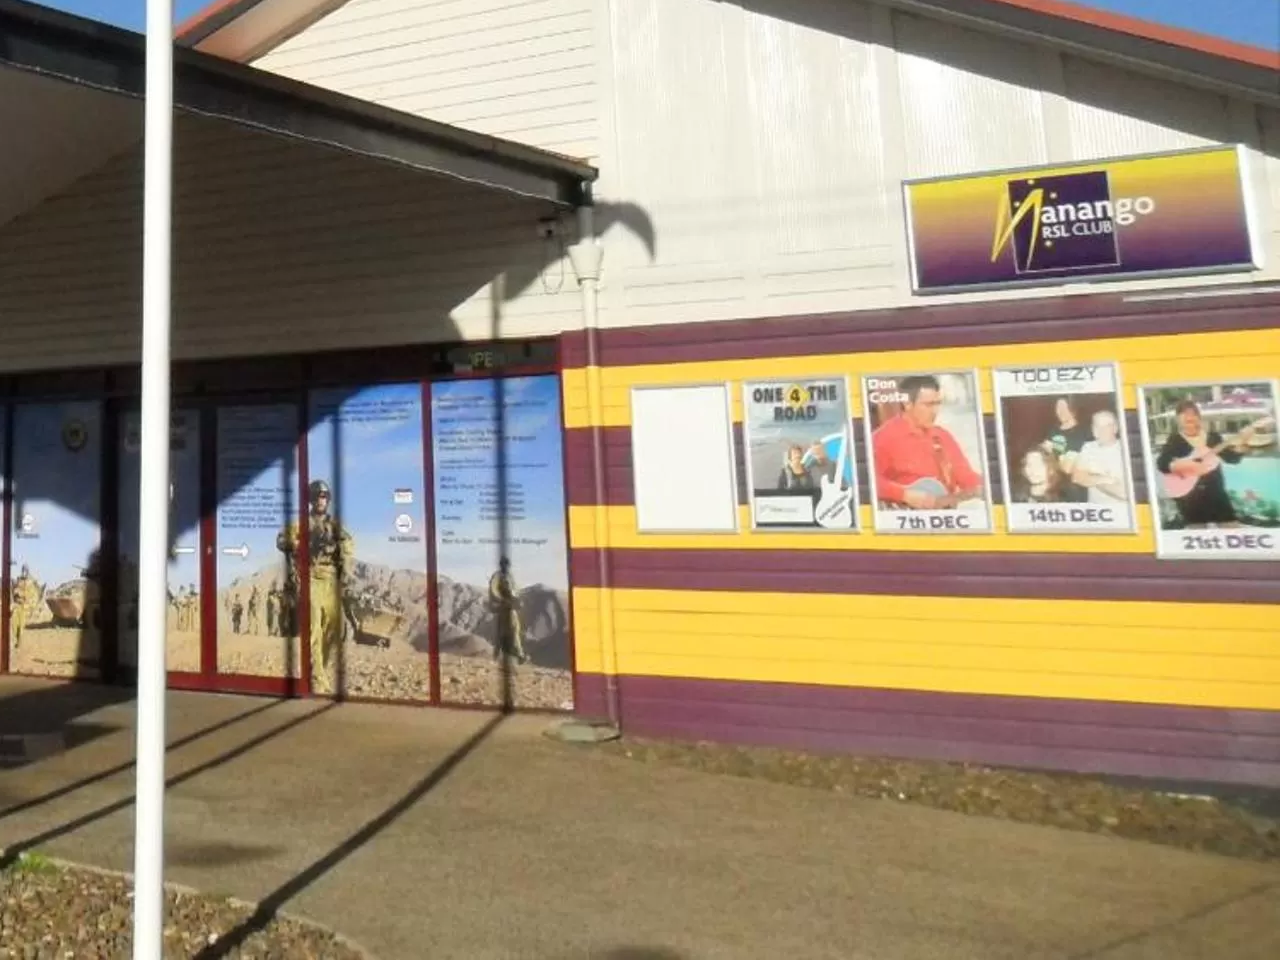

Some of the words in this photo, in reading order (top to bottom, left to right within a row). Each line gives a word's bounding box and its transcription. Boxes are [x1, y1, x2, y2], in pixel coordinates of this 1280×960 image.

[991, 187, 1155, 272] Nanango
[1041, 224, 1071, 239] RSL
[1072, 220, 1113, 236] CLUB
[1010, 367, 1051, 382] TOO
[1057, 364, 1097, 382] EZY
[868, 379, 897, 389] Don
[753, 387, 783, 403] ONE
[790, 388, 801, 403] 4
[809, 385, 837, 401] THE
[869, 391, 910, 403] Costa
[774, 405, 818, 421] ROAD
[896, 515, 926, 529] 7th
[929, 515, 970, 529] DEC
[1028, 508, 1067, 522] 14th
[1070, 508, 1114, 522] DEC
[1182, 535, 1222, 550] 21st
[1225, 534, 1273, 549] DEC
